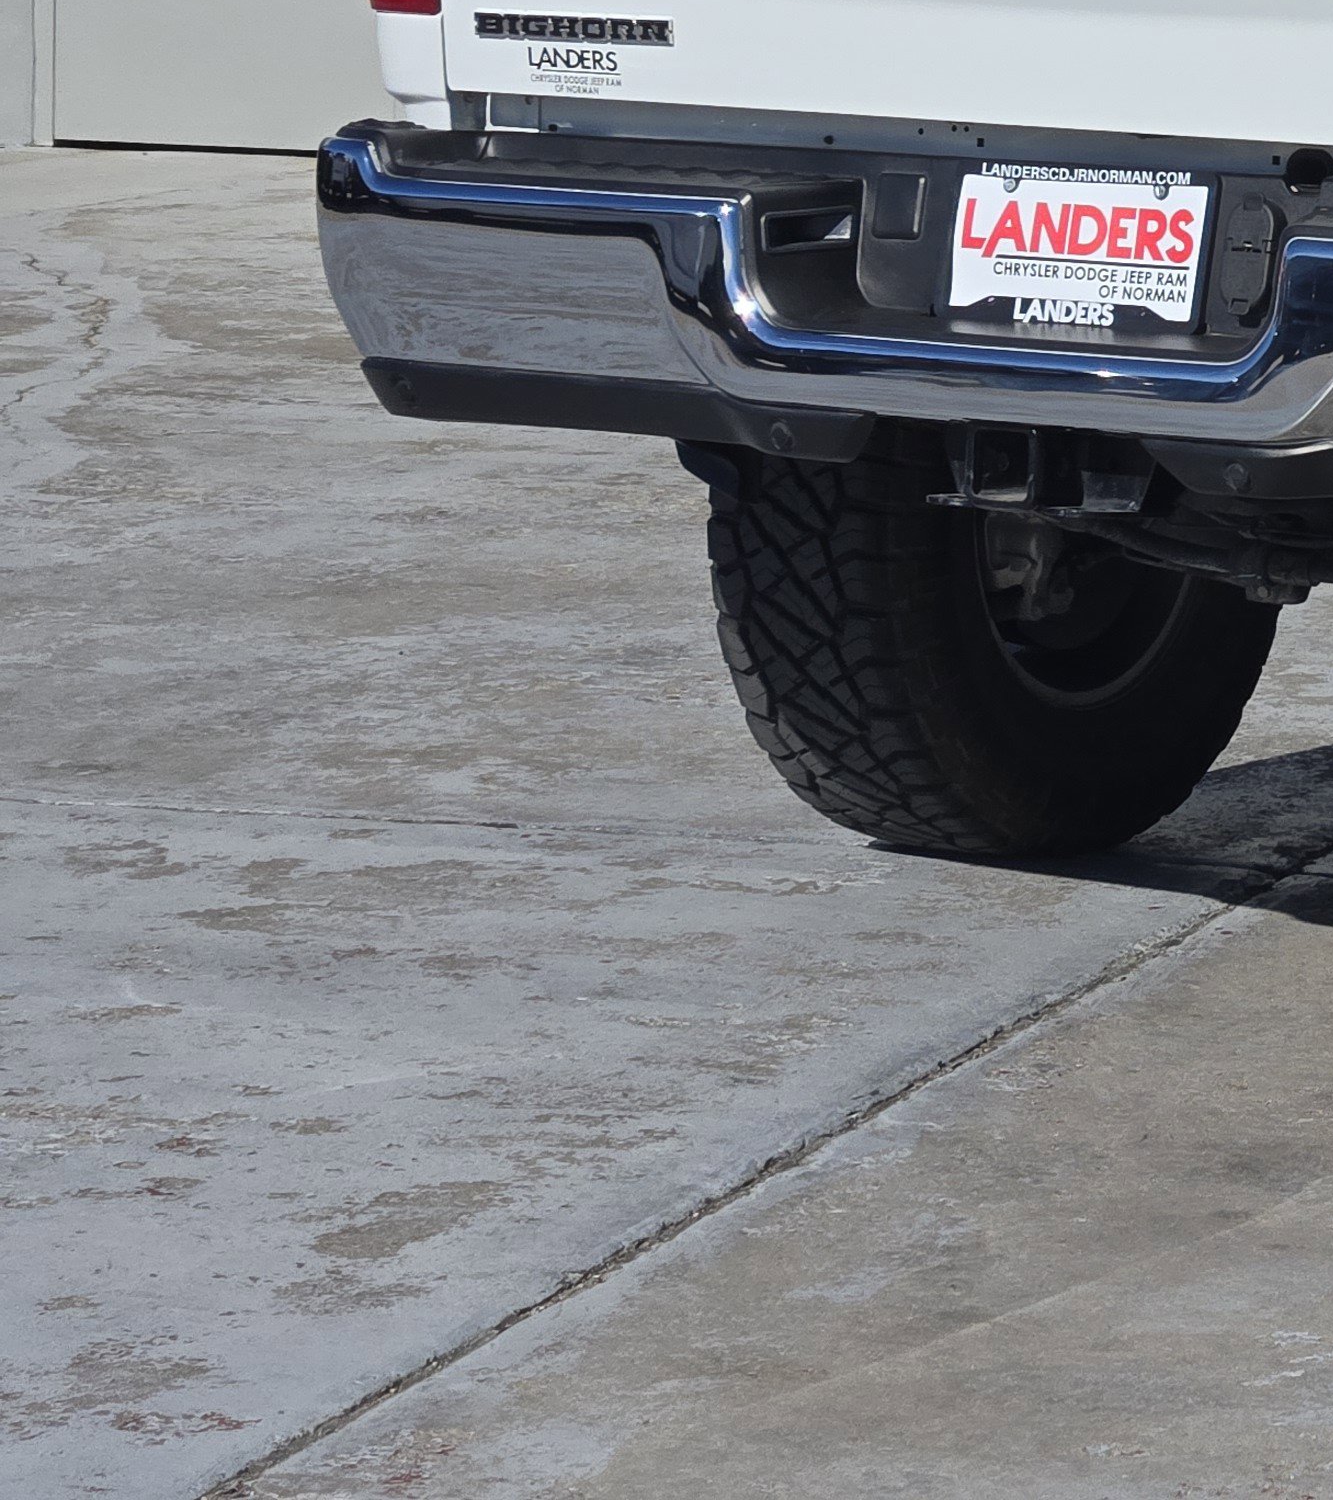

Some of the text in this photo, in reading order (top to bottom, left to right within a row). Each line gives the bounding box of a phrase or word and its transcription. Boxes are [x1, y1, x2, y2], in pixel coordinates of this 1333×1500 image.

[474, 11, 674, 46] BIGHORN
[527, 46, 618, 72] LANDERS
[531, 73, 562, 84] CHRYSLER
[564, 75, 588, 85] DODGE
[555, 85, 599, 95] OF NORMAN
[981, 162, 1191, 185] LANDERSCDJRNORMAN.COM
[961, 198, 1195, 263] LANDERS
[993, 261, 1188, 287] CHRYSLER DODGE JEEP RAM
[1099, 285, 1187, 303] OF NORMAN
[1013, 297, 1114, 327] LANDERS
